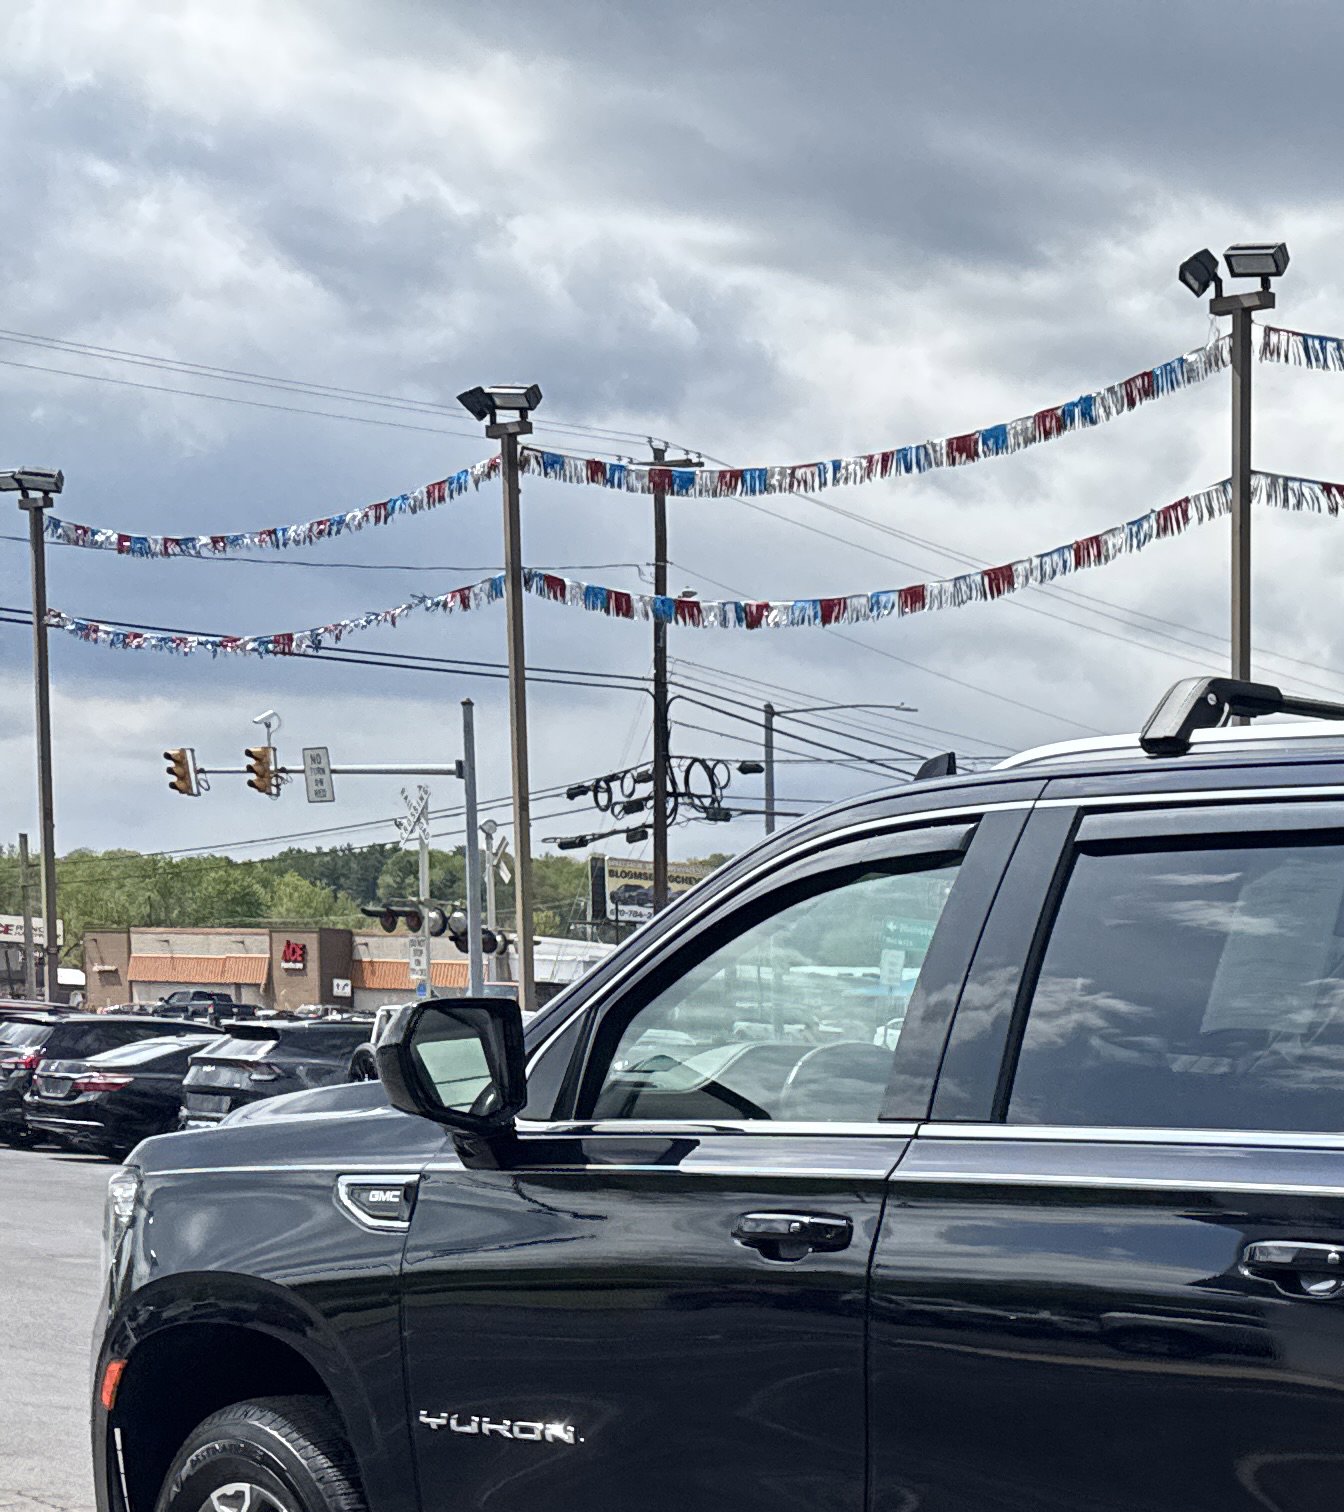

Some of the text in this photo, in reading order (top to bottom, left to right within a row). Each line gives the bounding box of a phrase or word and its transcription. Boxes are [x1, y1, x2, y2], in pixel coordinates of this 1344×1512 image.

[310, 752, 322, 766] NO
[281, 940, 307, 962] ACE
[368, 1190, 401, 1202] GMC
[418, 1409, 577, 1444] YUKON
